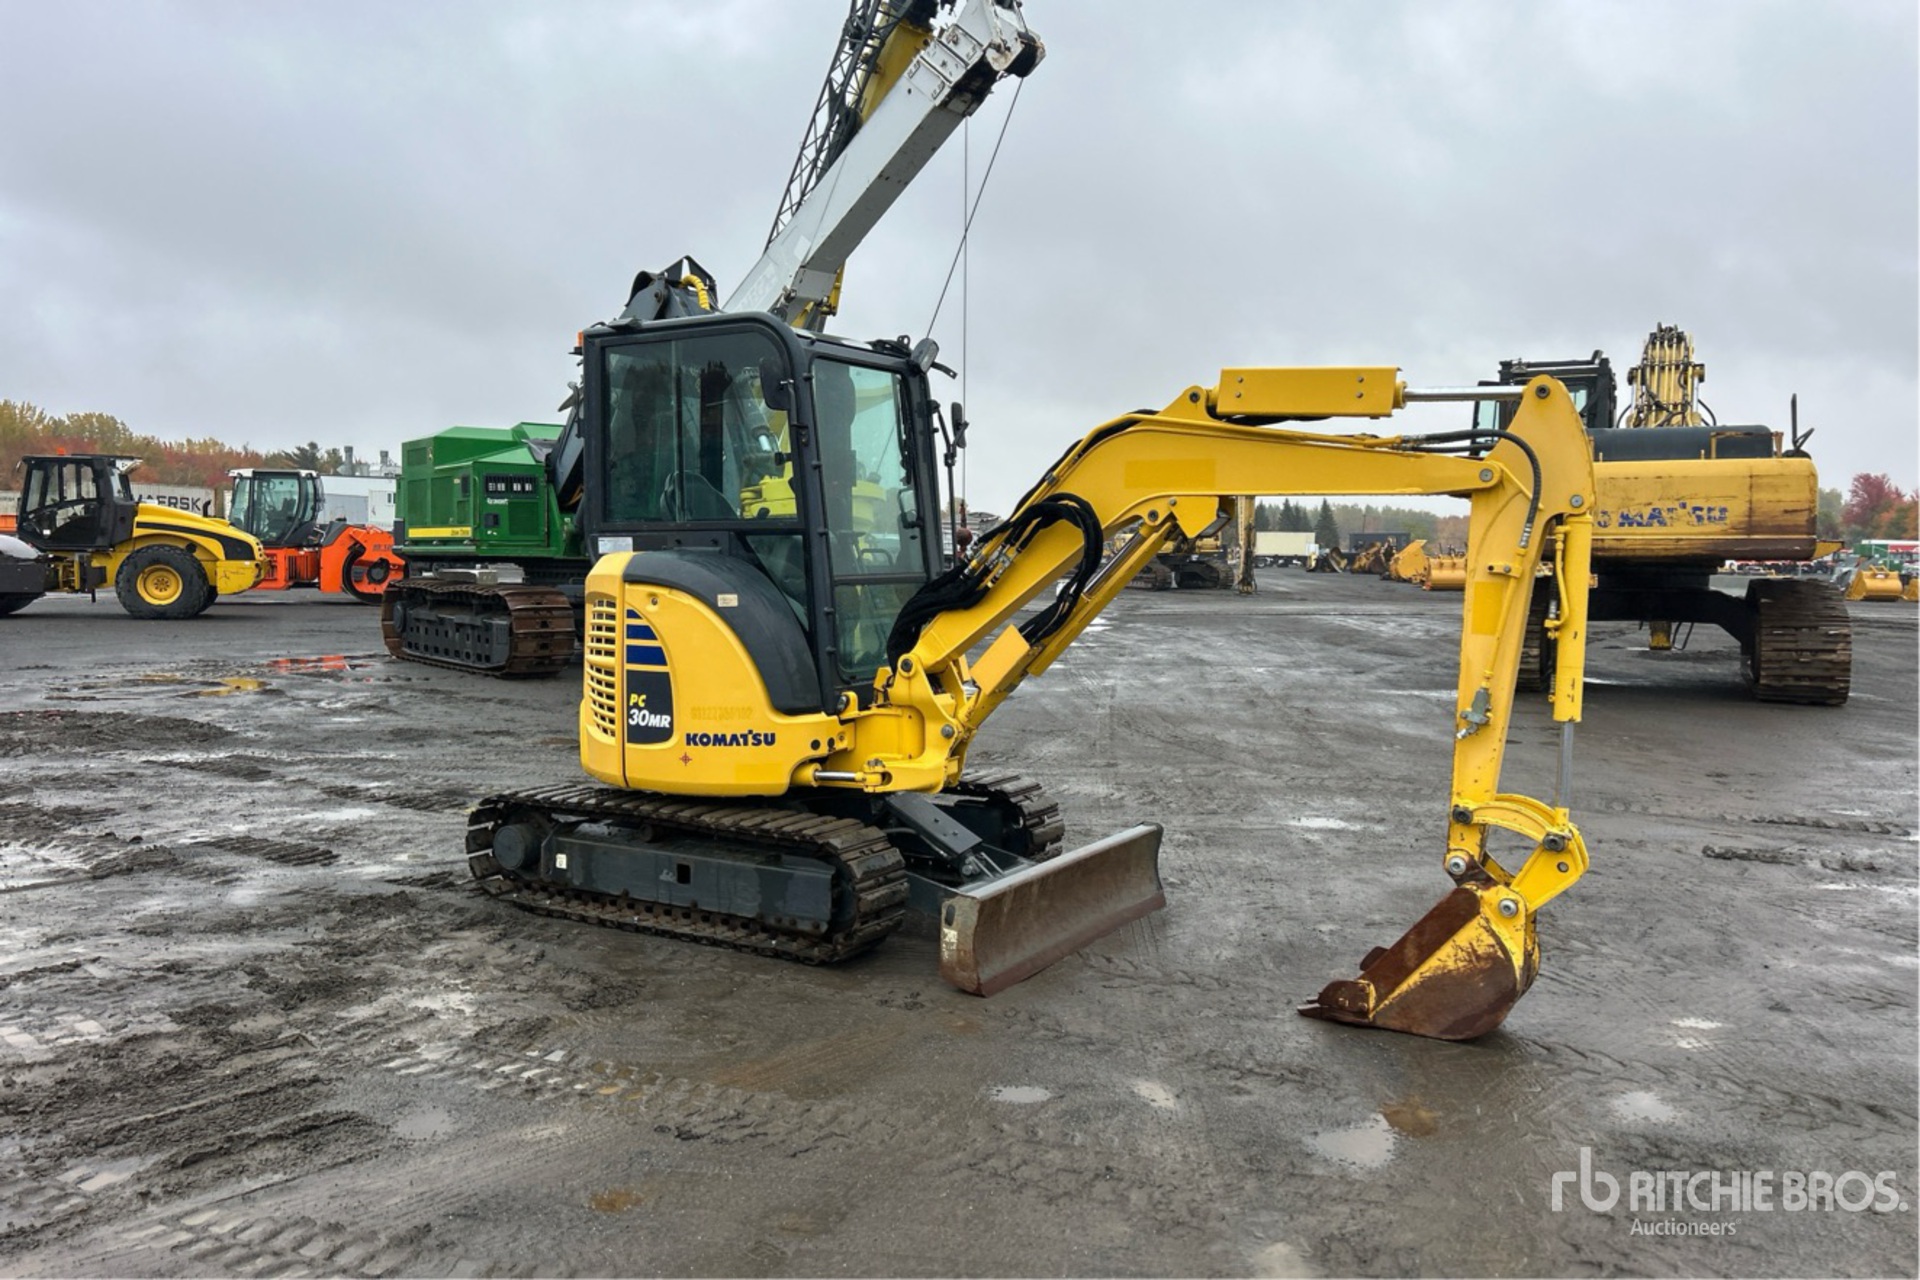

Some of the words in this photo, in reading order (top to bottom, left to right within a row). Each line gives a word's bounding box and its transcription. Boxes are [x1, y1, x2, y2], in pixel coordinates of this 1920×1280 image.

[629, 693, 647, 707] PC
[628, 708, 672, 728] 30MR
[685, 729, 776, 747] KOMATSU
